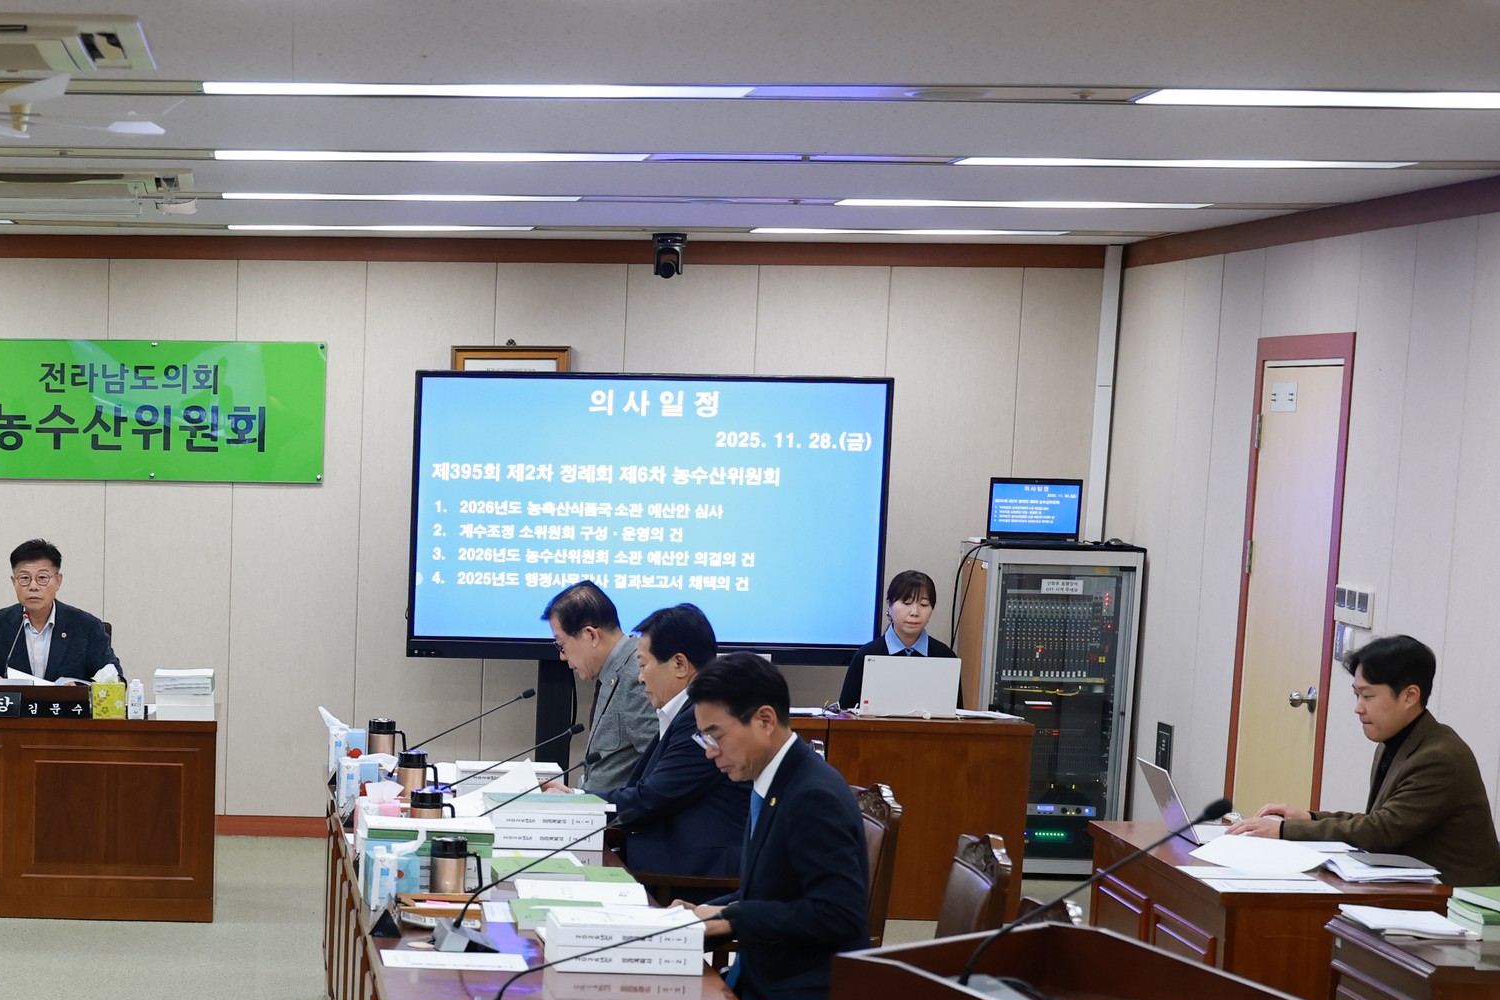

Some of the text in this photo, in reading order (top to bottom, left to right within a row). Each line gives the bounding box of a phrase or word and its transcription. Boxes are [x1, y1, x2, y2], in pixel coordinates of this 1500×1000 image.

[38, 361, 220, 395] 전라남도의회
[715, 431, 872, 452] 2025. 11. 28.(금)
[431, 461, 781, 487] 제395회 제2차 정례회 제6차 농수산위원회
[434, 500, 724, 520] 1. 2026년도 농축산식품국 소관 예산안 심사
[432, 523, 447, 537] 2.
[459, 523, 515, 539] 계수조정
[518, 525, 576, 541] 소위원회
[579, 526, 609, 541] 구성
[621, 527, 665, 542] 운영의
[668, 527, 684, 543] 건
[432, 547, 755, 568] 3. 2026년도 농수산위원회 소관 예산안 의결의 건
[431, 570, 445, 585] 4.
[456, 571, 520, 587] 2025년도
[613, 573, 684, 590] 결과보고서
[688, 575, 731, 591] 채택의
[734, 576, 750, 592] 건
[27, 702, 84, 716] 김문수
